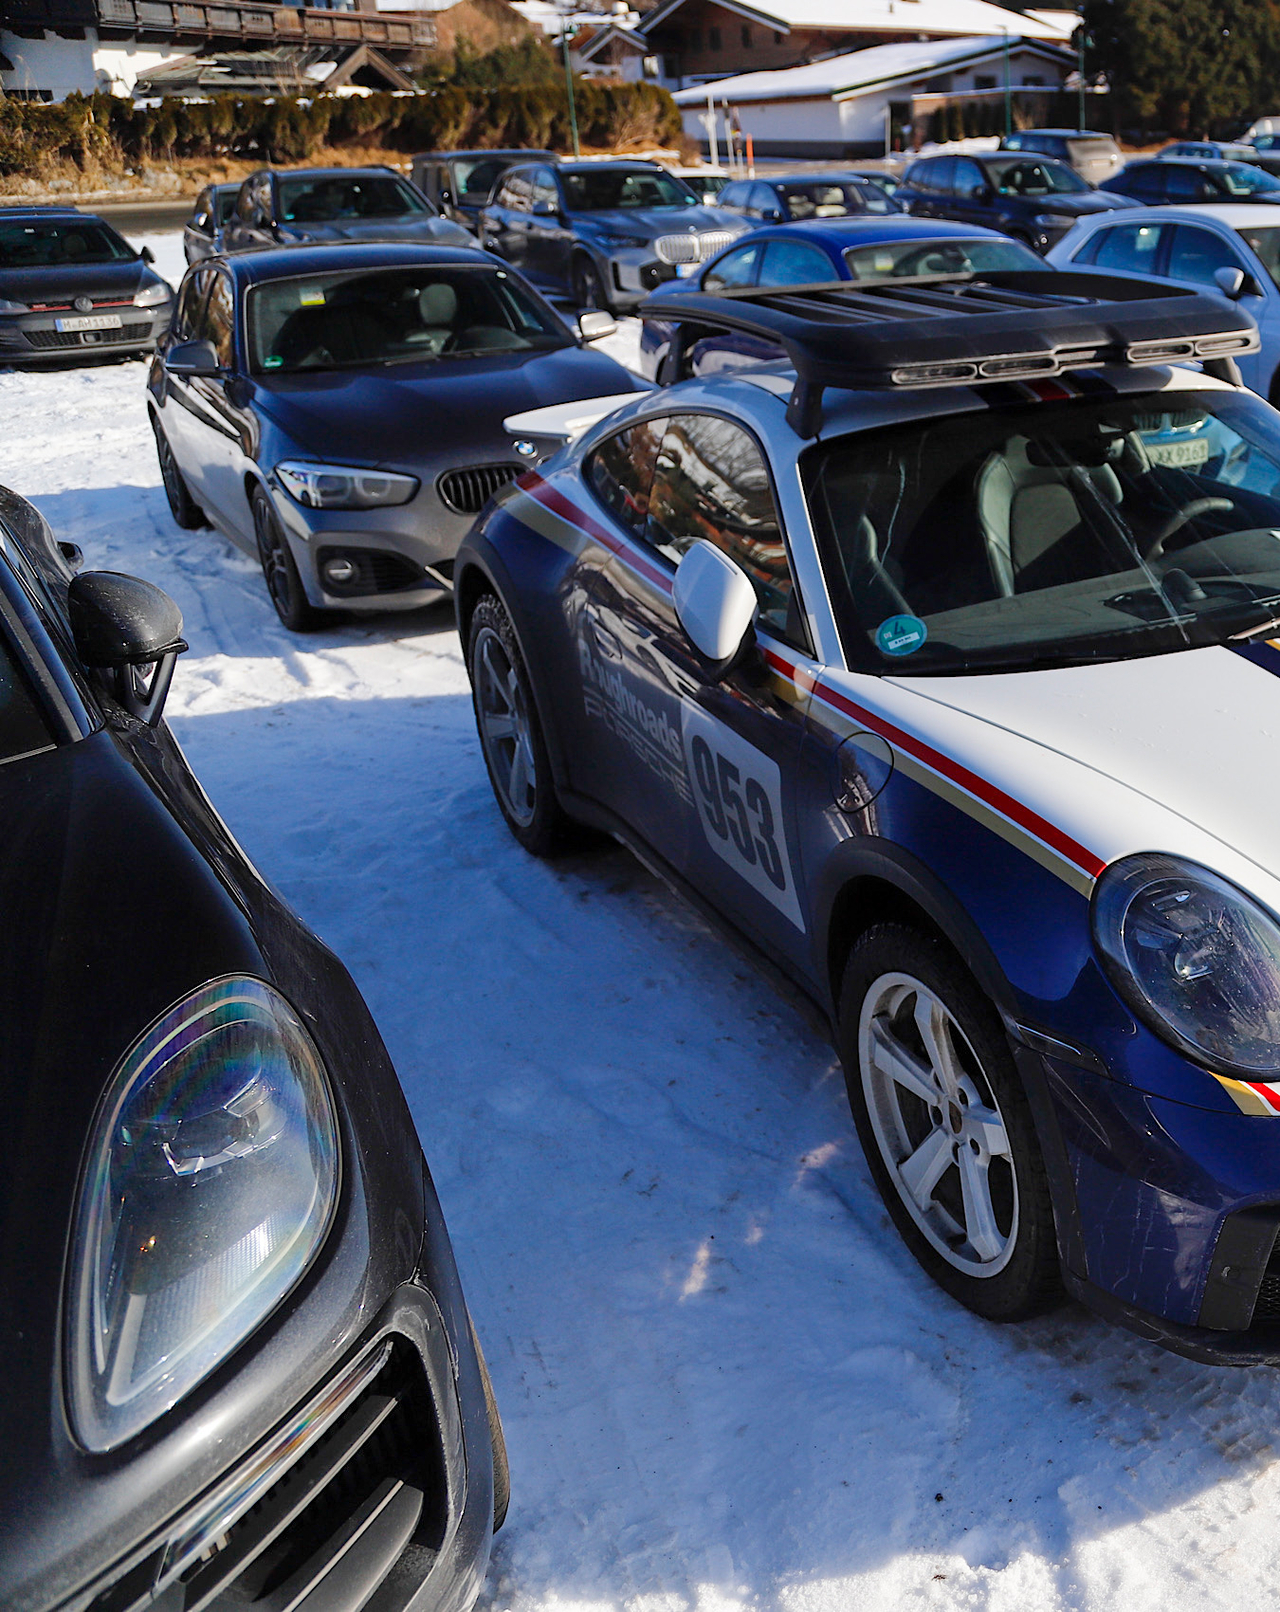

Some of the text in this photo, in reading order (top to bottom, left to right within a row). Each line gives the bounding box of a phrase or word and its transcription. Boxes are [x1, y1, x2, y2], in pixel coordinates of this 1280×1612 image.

[893, 620, 907, 636] 4
[577, 637, 683, 762] Roughroads
[691, 734, 786, 892] 953
